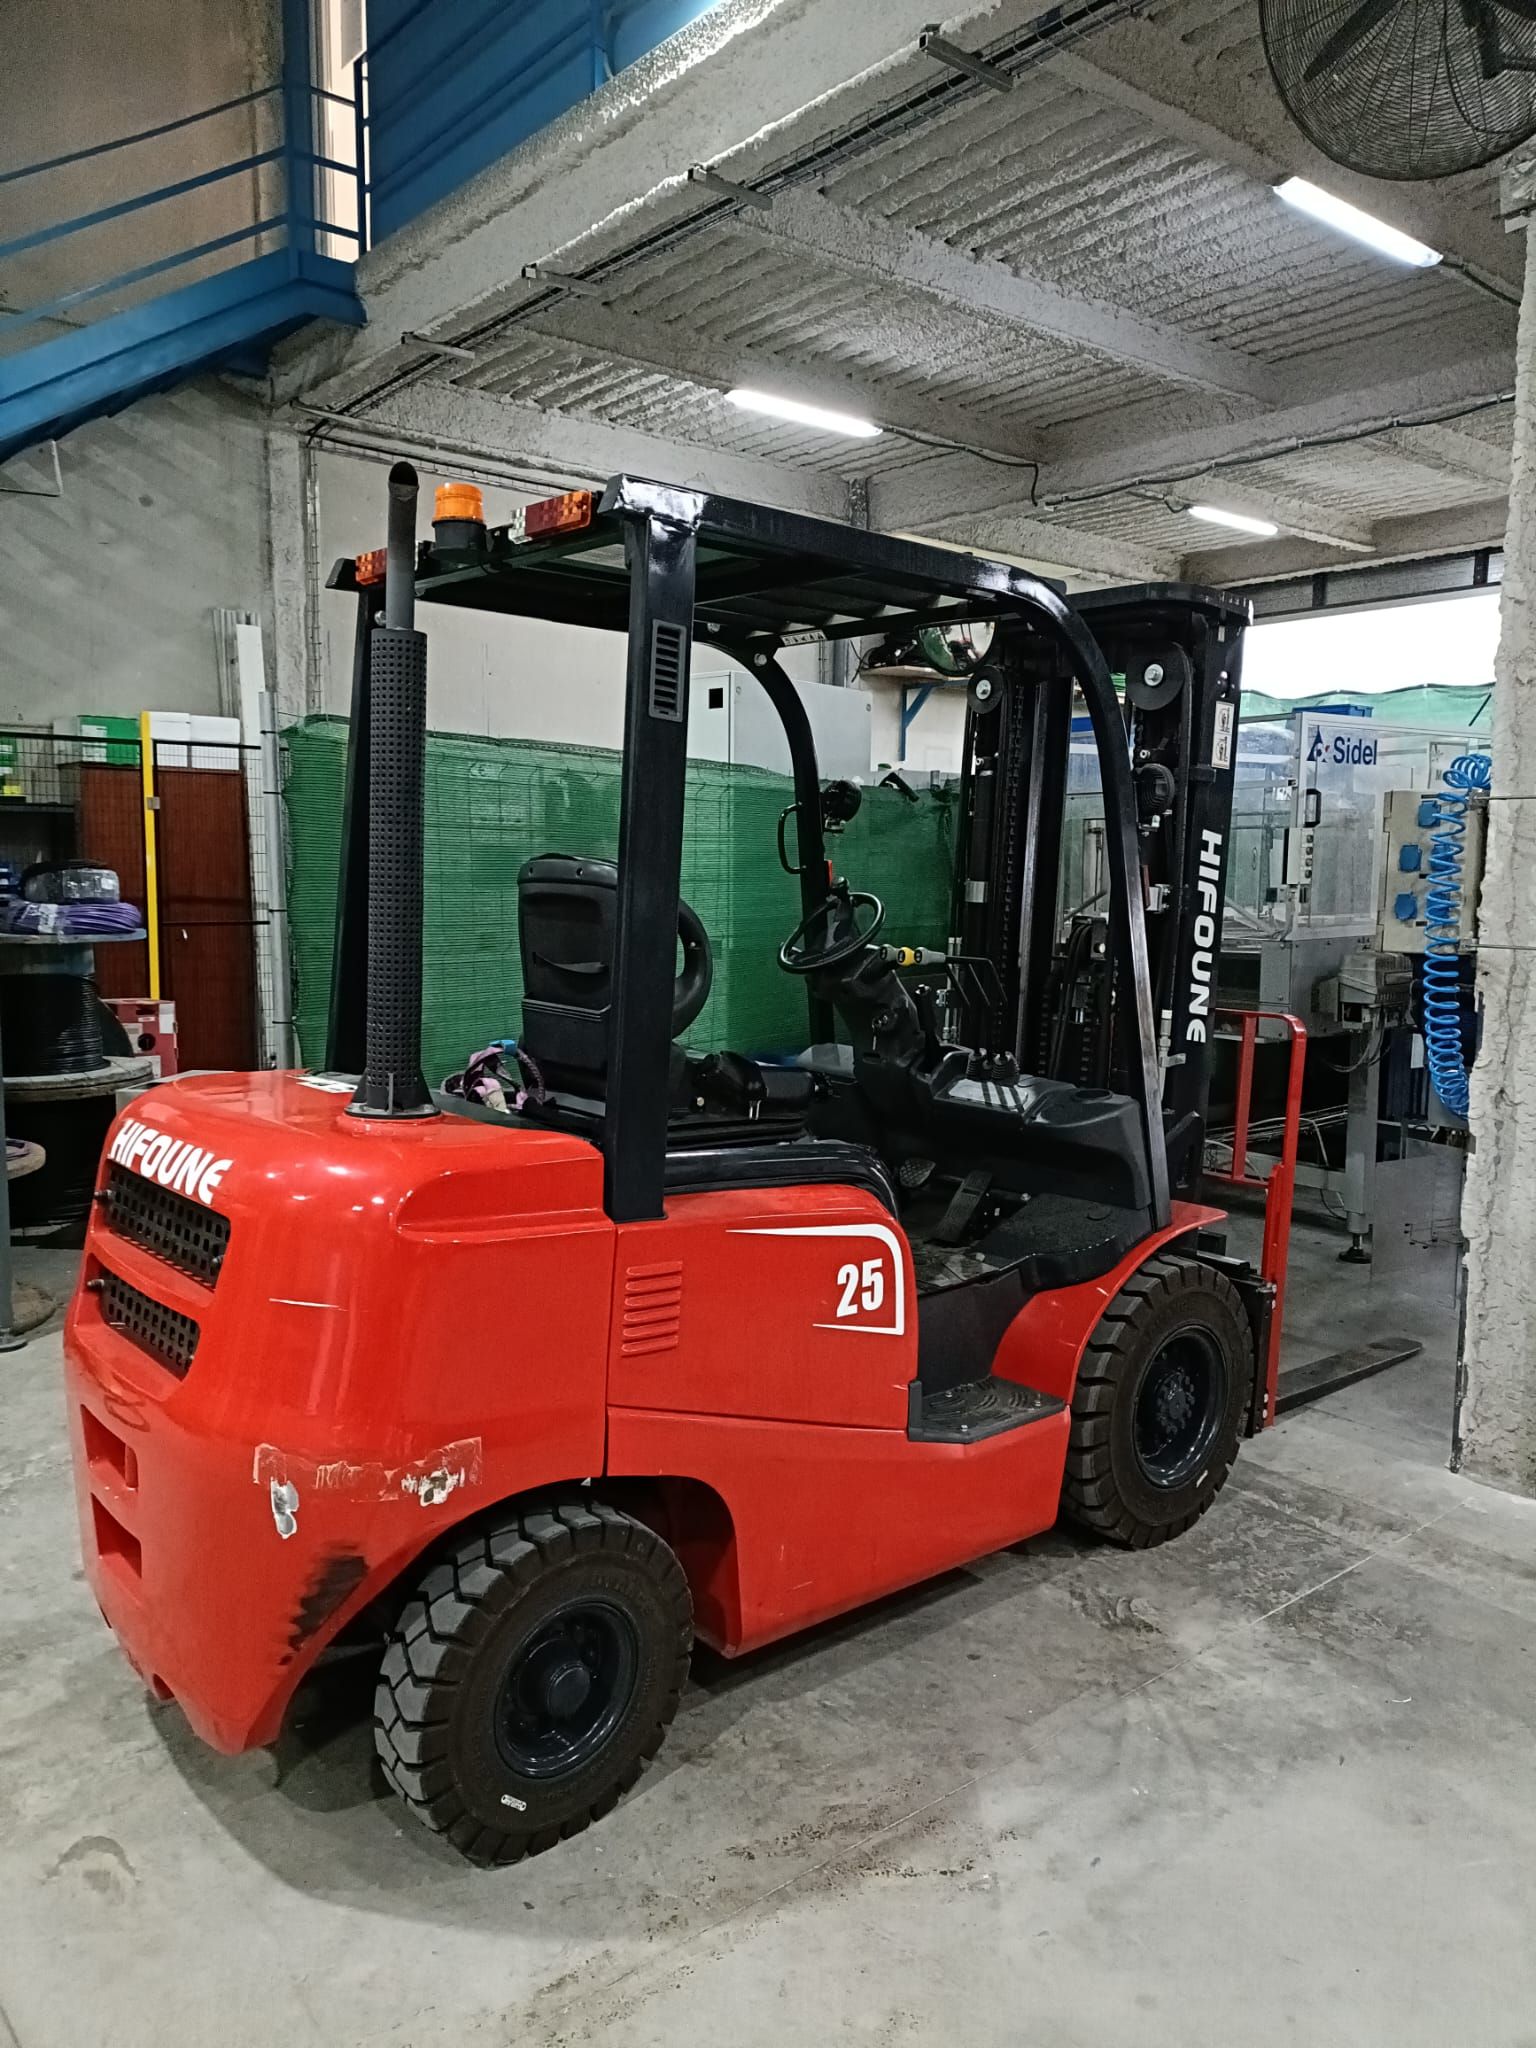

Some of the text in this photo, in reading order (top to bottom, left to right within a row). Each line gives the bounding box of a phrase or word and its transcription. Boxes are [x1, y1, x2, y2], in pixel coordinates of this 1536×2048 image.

[1333, 736, 1378, 765] Sidel
[1186, 829, 1223, 1043] HIFOUNE
[107, 1119, 234, 1205] HIFOUNE
[836, 1258, 884, 1318] 25
